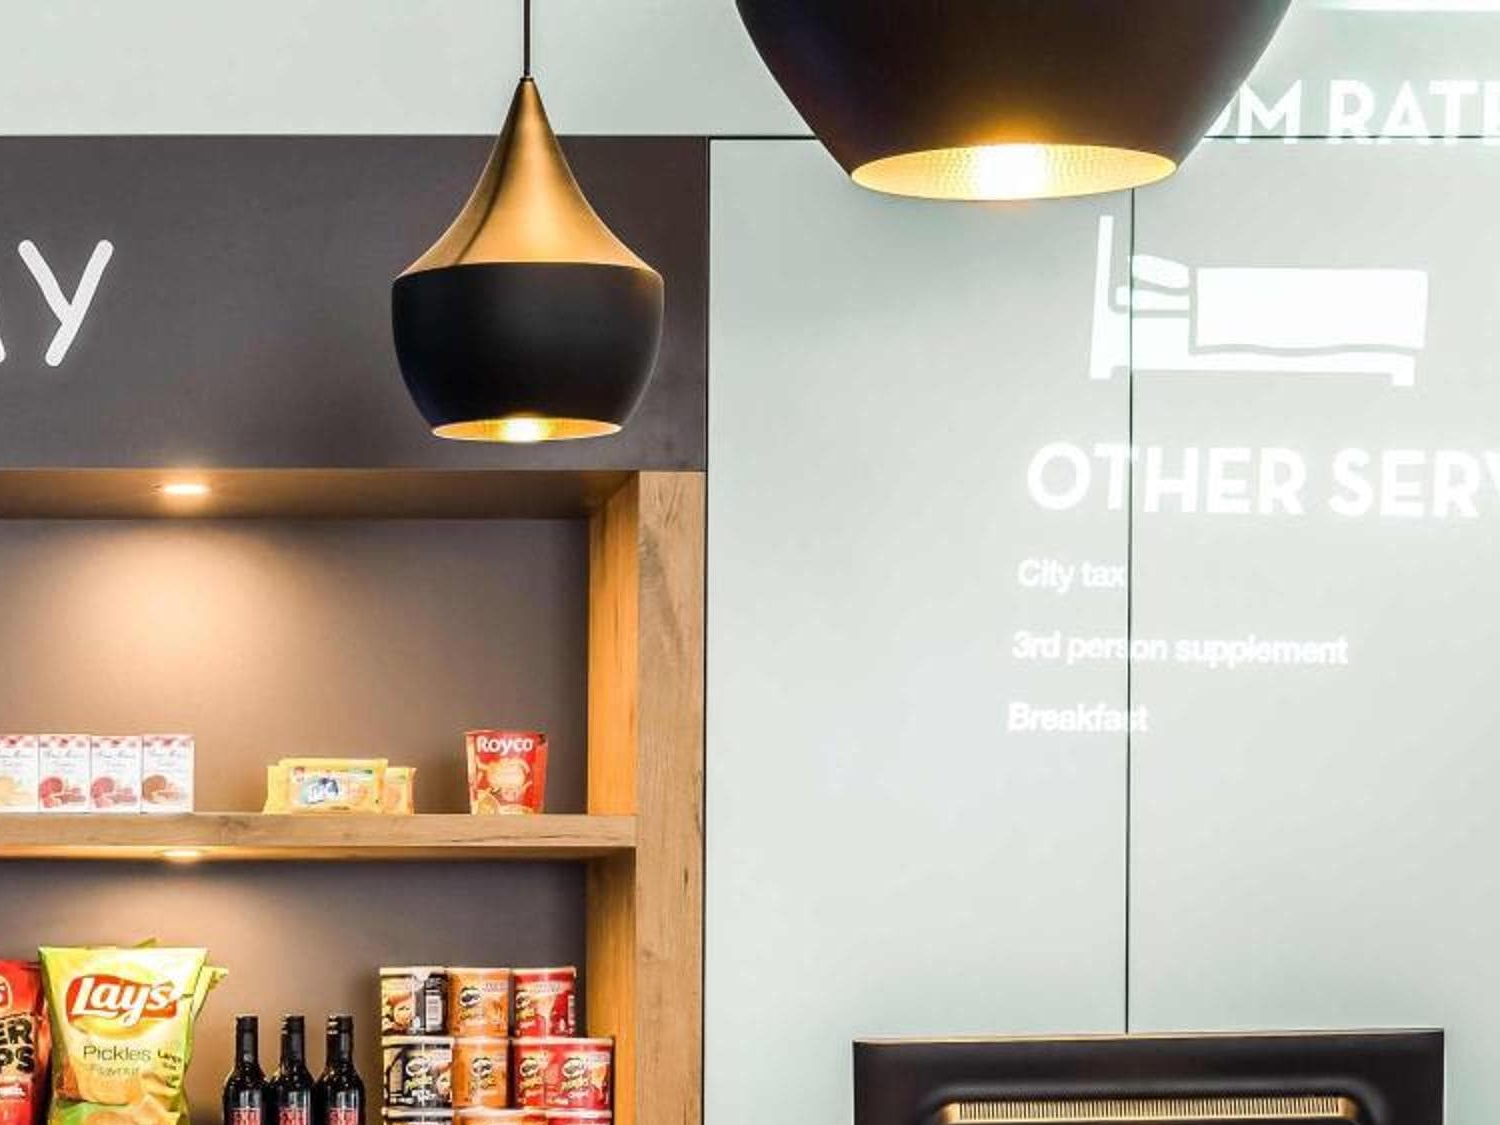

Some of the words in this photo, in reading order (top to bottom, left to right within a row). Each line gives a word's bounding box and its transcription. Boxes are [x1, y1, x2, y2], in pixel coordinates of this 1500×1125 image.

[1027, 441, 1307, 515] OTHER
[1016, 557, 1073, 595] City
[1080, 558, 1126, 588] tax
[1011, 630, 1061, 661] 3rd
[1066, 634, 1168, 664] person
[1174, 633, 1350, 669] supplement
[1006, 701, 1150, 734] Breakfast
[83, 1045, 152, 1062] Pickles
